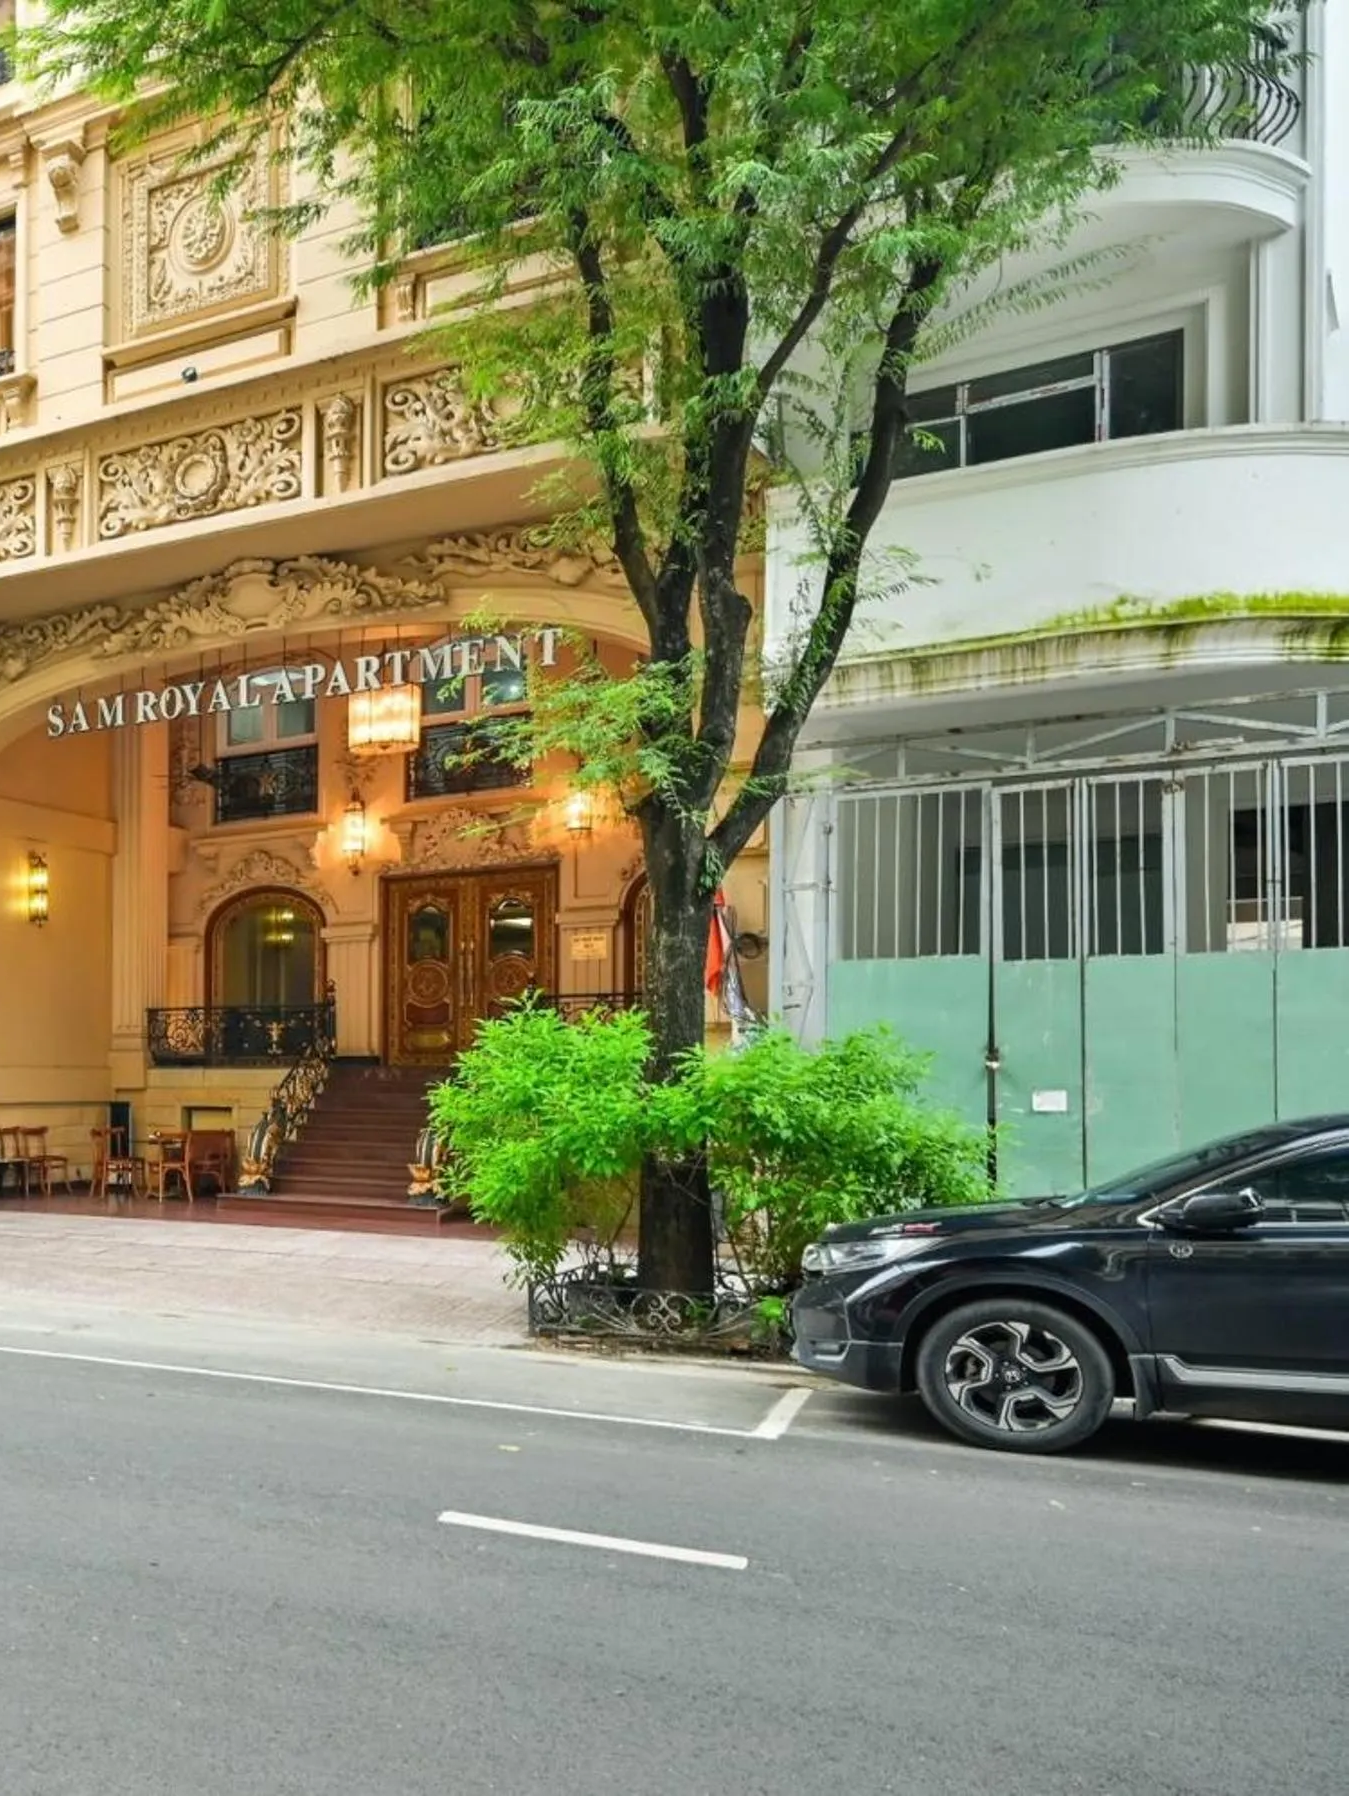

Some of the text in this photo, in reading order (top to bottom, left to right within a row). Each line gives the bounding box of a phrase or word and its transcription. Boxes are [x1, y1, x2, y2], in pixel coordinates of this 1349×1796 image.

[48, 627, 564, 738] SAM ROYAL APARTMENT
